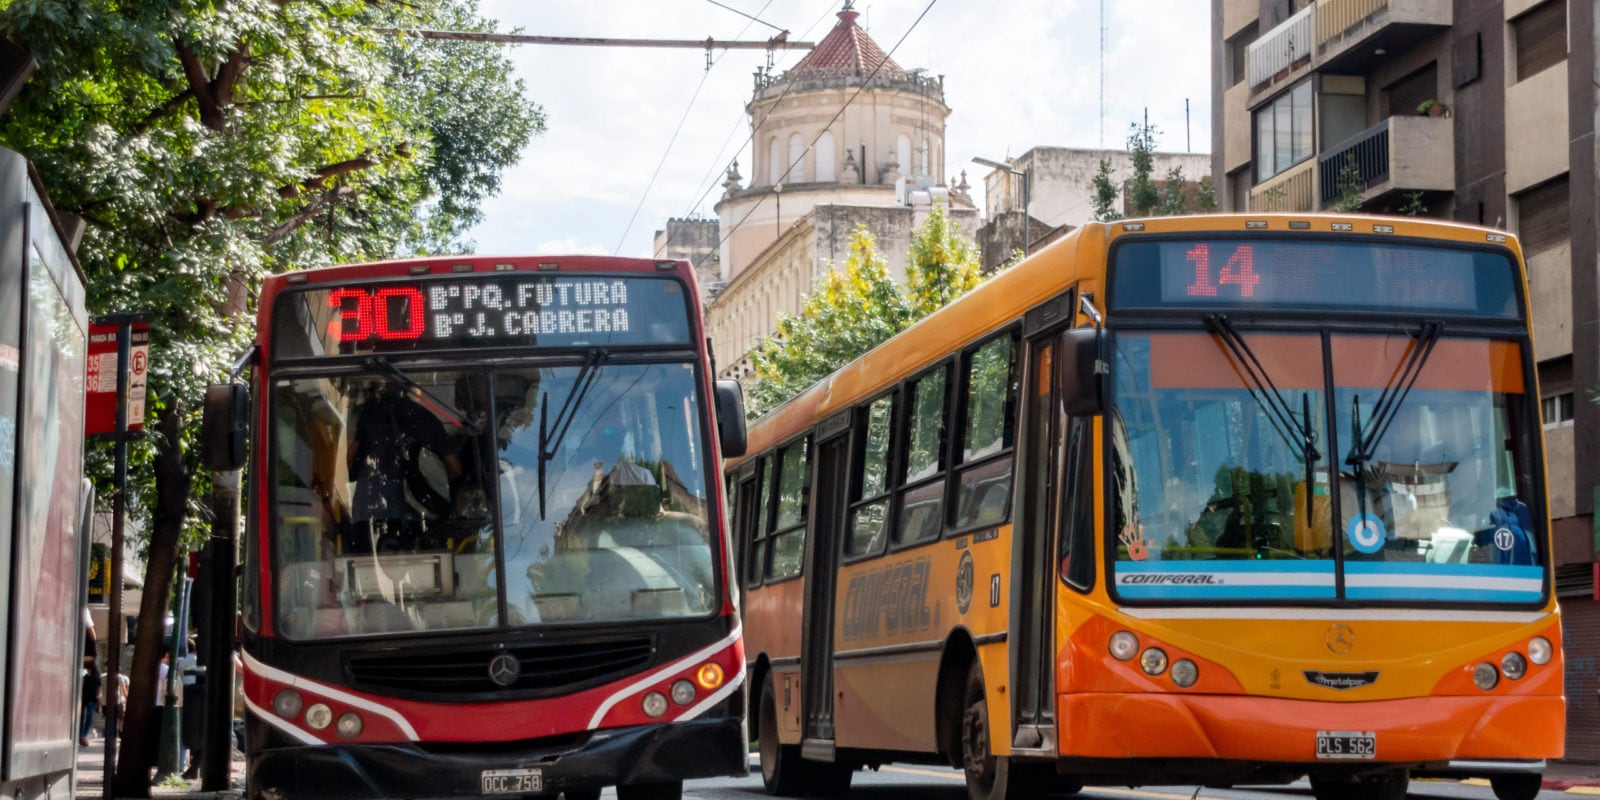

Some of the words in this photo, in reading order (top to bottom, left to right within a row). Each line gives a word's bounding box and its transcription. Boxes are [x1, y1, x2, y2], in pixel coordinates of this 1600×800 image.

[1186, 244, 1260, 297] 14
[328, 286, 425, 341] 30
[504, 308, 629, 335] CABRERA
[88, 355, 99, 372] 35
[87, 375, 98, 391] 36
[1497, 532, 1510, 547] 17
[1121, 574, 1216, 585] CONIFERAL
[1318, 738, 1343, 753] PLS
[1349, 738, 1374, 754] 562
[516, 775, 540, 791] 758
